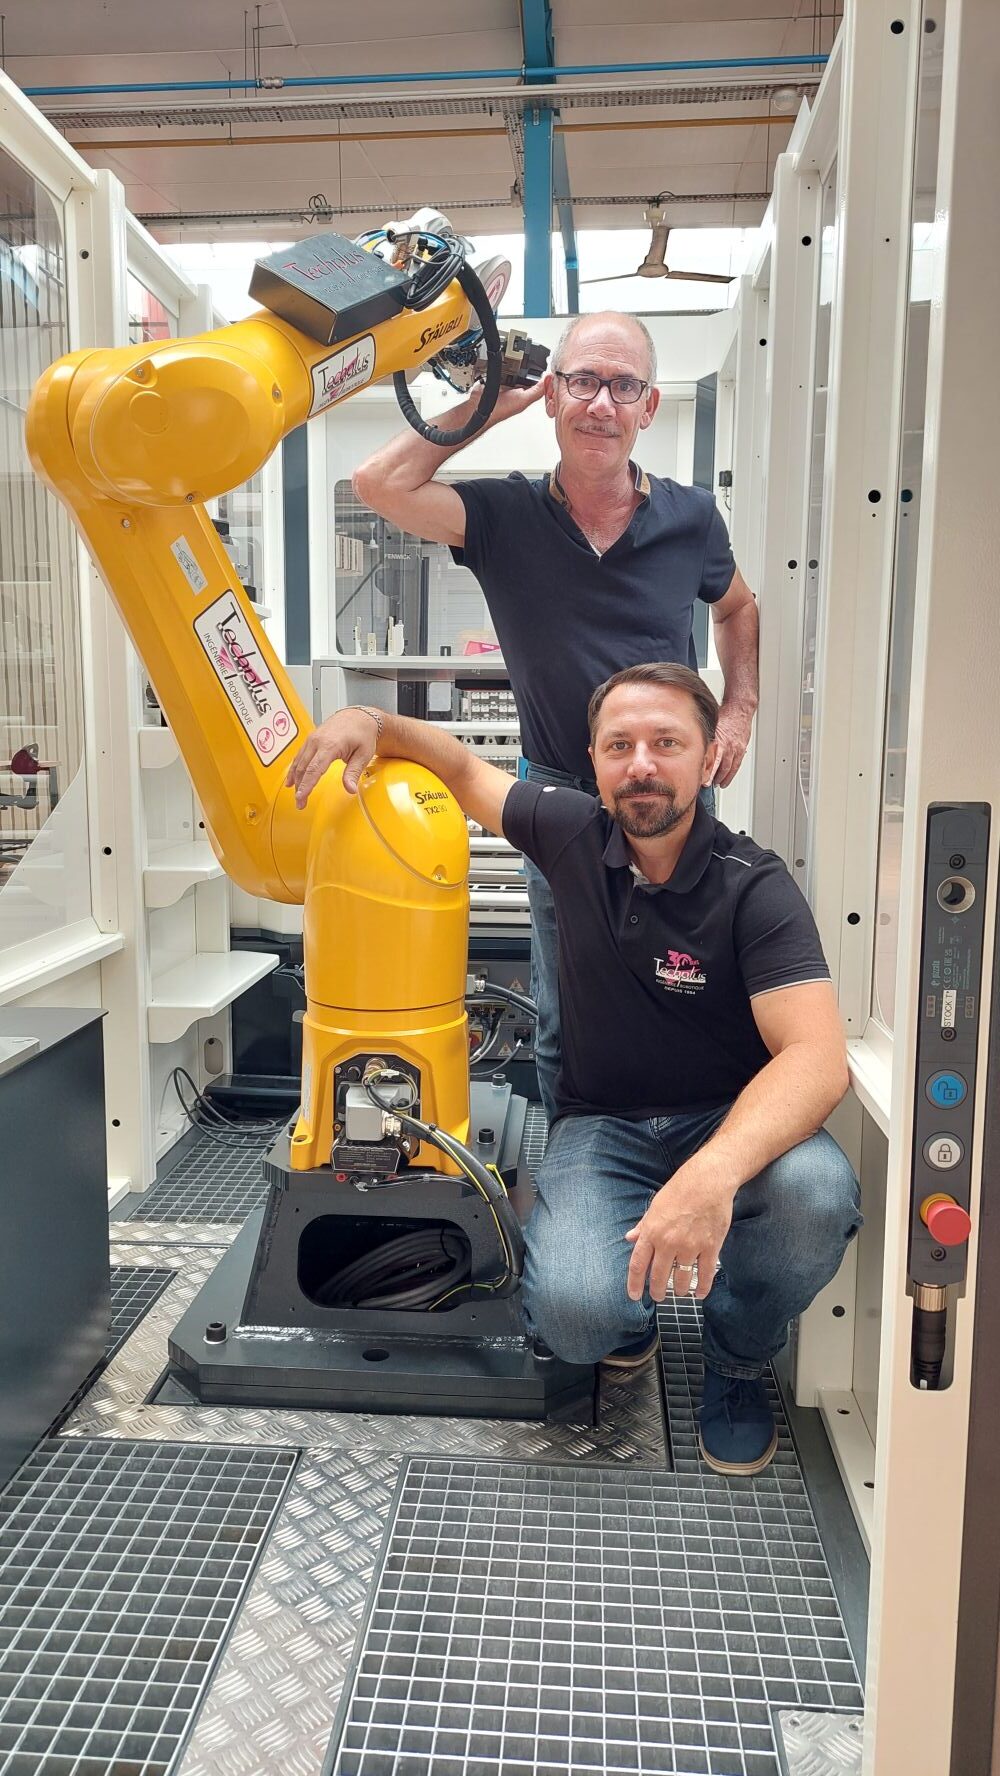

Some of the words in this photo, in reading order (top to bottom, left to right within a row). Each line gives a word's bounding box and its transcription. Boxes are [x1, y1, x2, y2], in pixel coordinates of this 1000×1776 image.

[282, 247, 365, 283] Techplus
[413, 314, 463, 353] STÄUBLI
[318, 346, 371, 393] Techplus
[217, 601, 272, 718] Techplus
[227, 680, 254, 727] ROBOTIQUE
[415, 791, 448, 804] STÄUBLI
[653, 957, 707, 988] Techplus
[943, 1000, 953, 1027] STOCK
